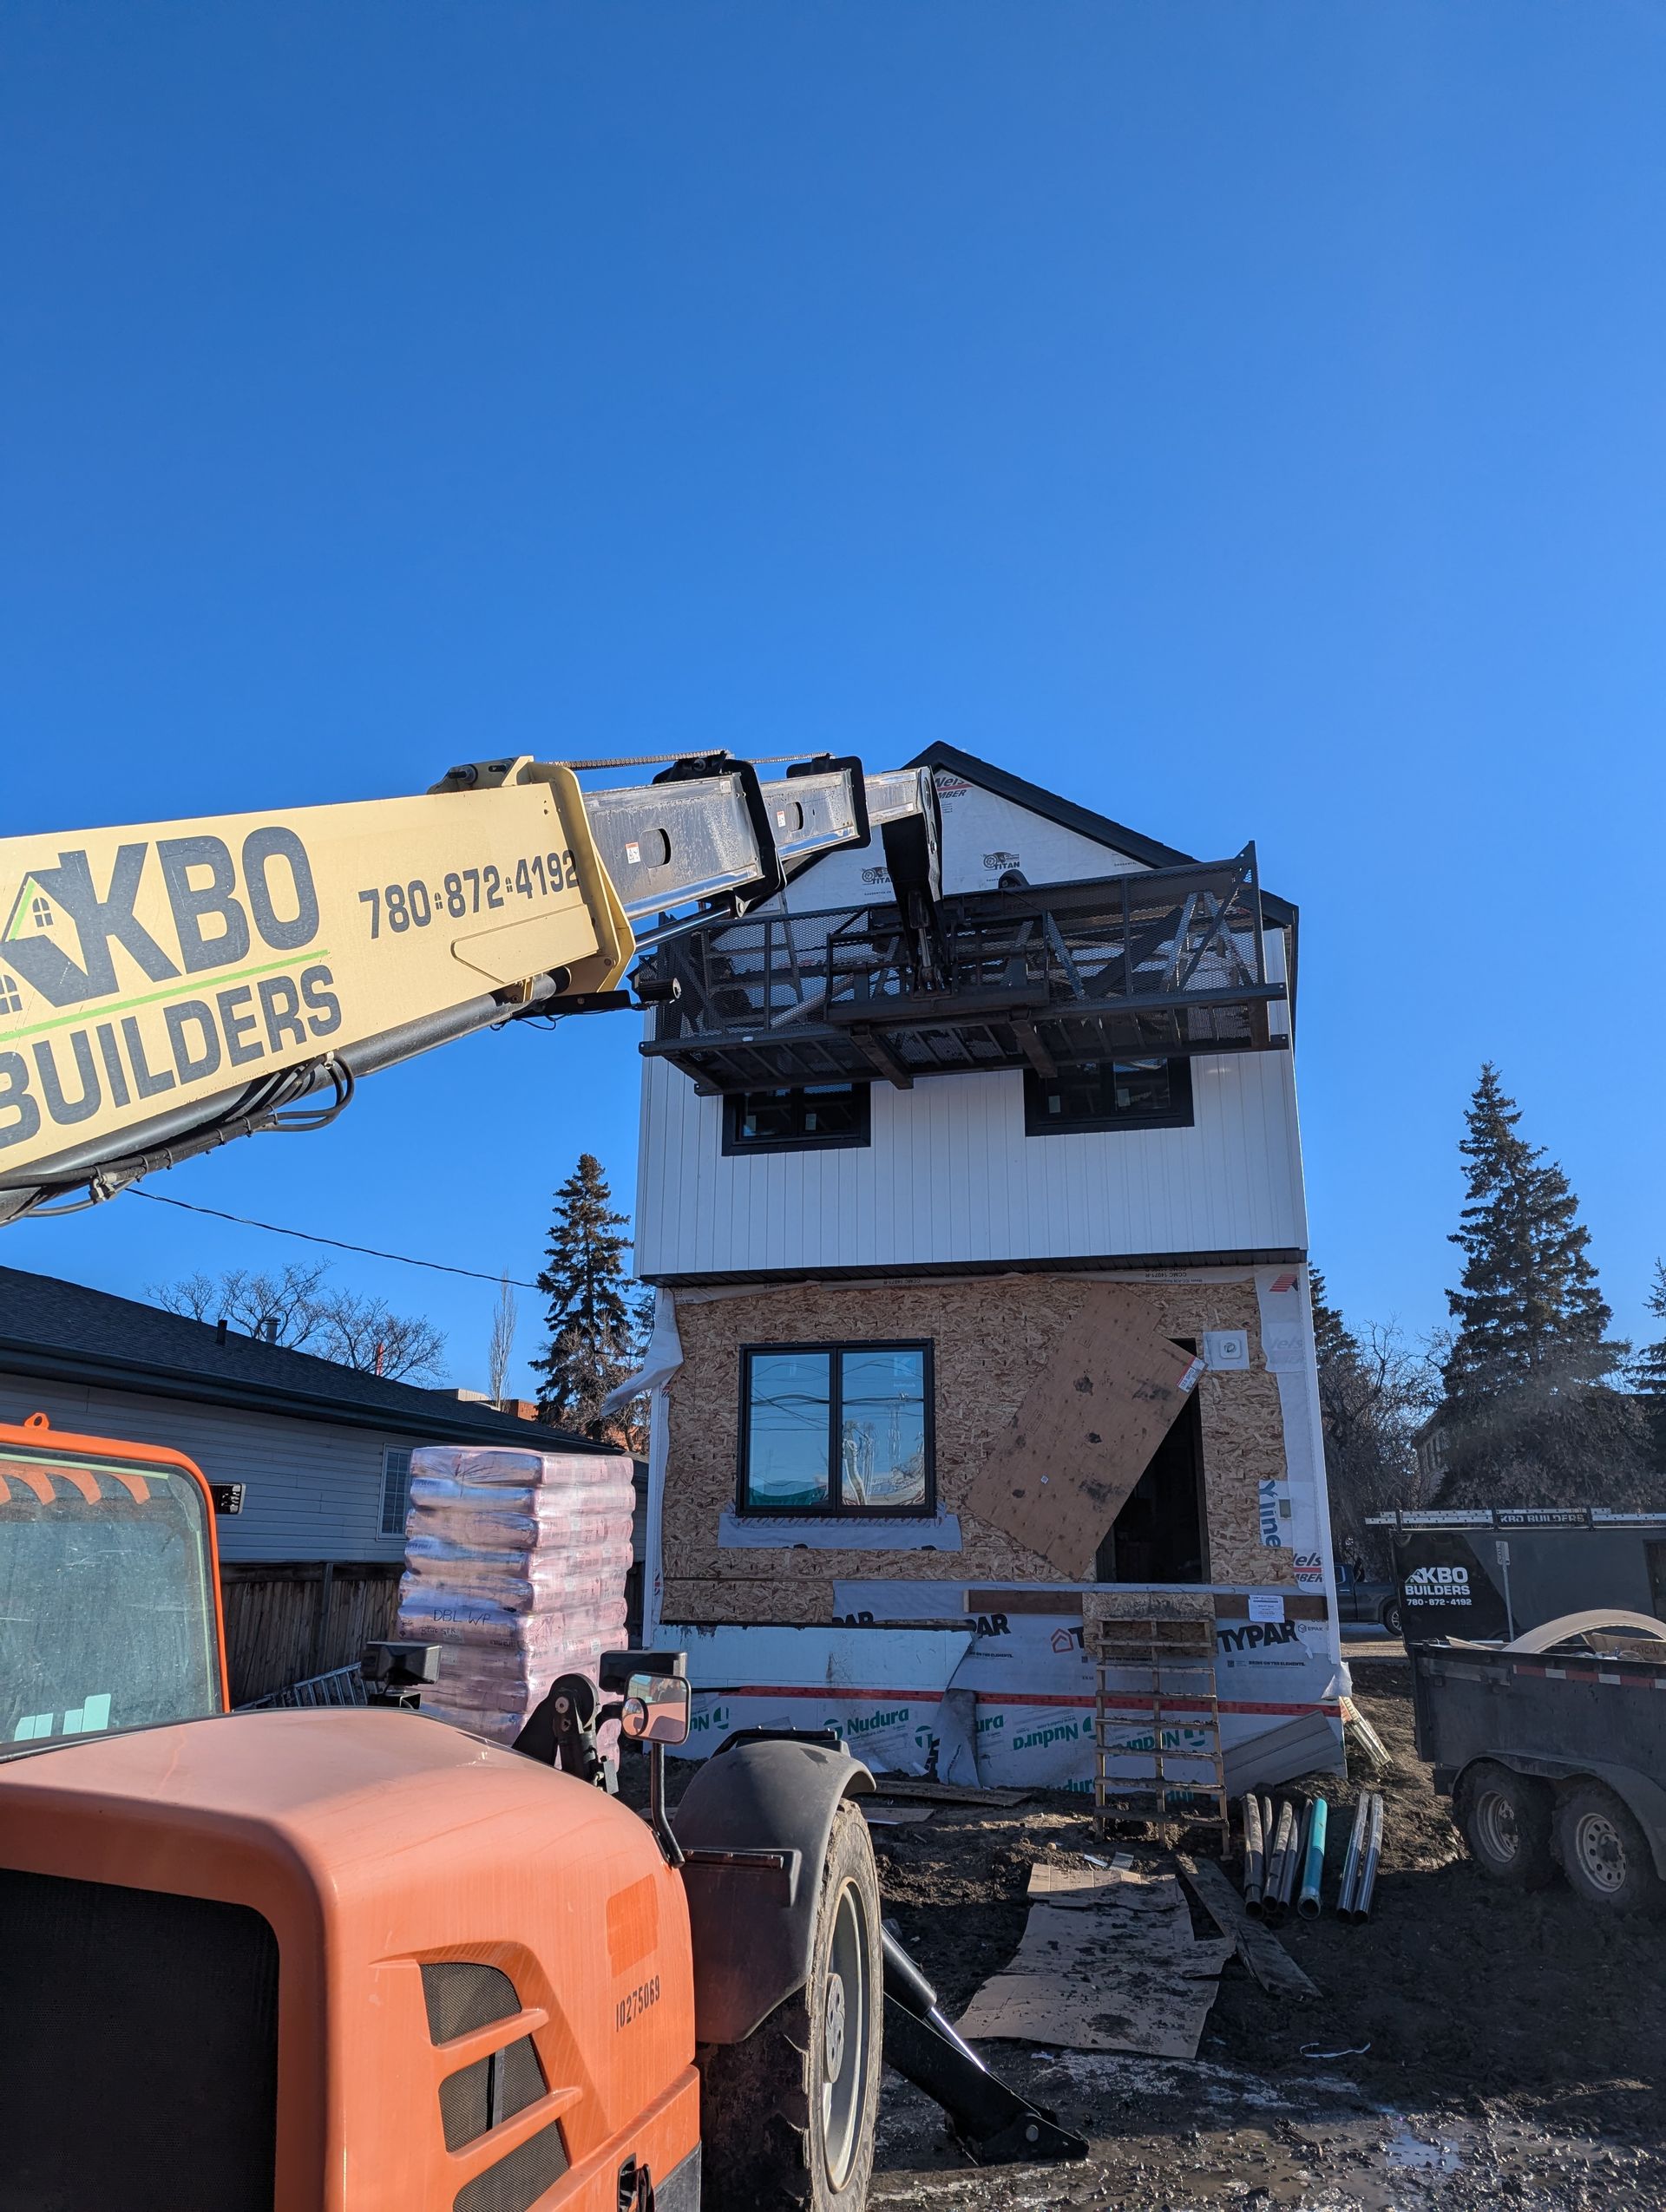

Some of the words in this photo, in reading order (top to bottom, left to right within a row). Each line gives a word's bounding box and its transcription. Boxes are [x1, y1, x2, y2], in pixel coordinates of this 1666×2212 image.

[994, 861, 1020, 870] TITAN
[1527, 1513, 1586, 1523] BUILDERS
[1405, 1584, 1471, 1596] BUILDERS
[433, 1608, 462, 1623] DBL
[1217, 1619, 1300, 1652] TYPAR
[847, 1708, 909, 1735] Nudura
[1013, 1723, 1079, 1751] Nudura
[615, 1973, 660, 2033] 10275069
